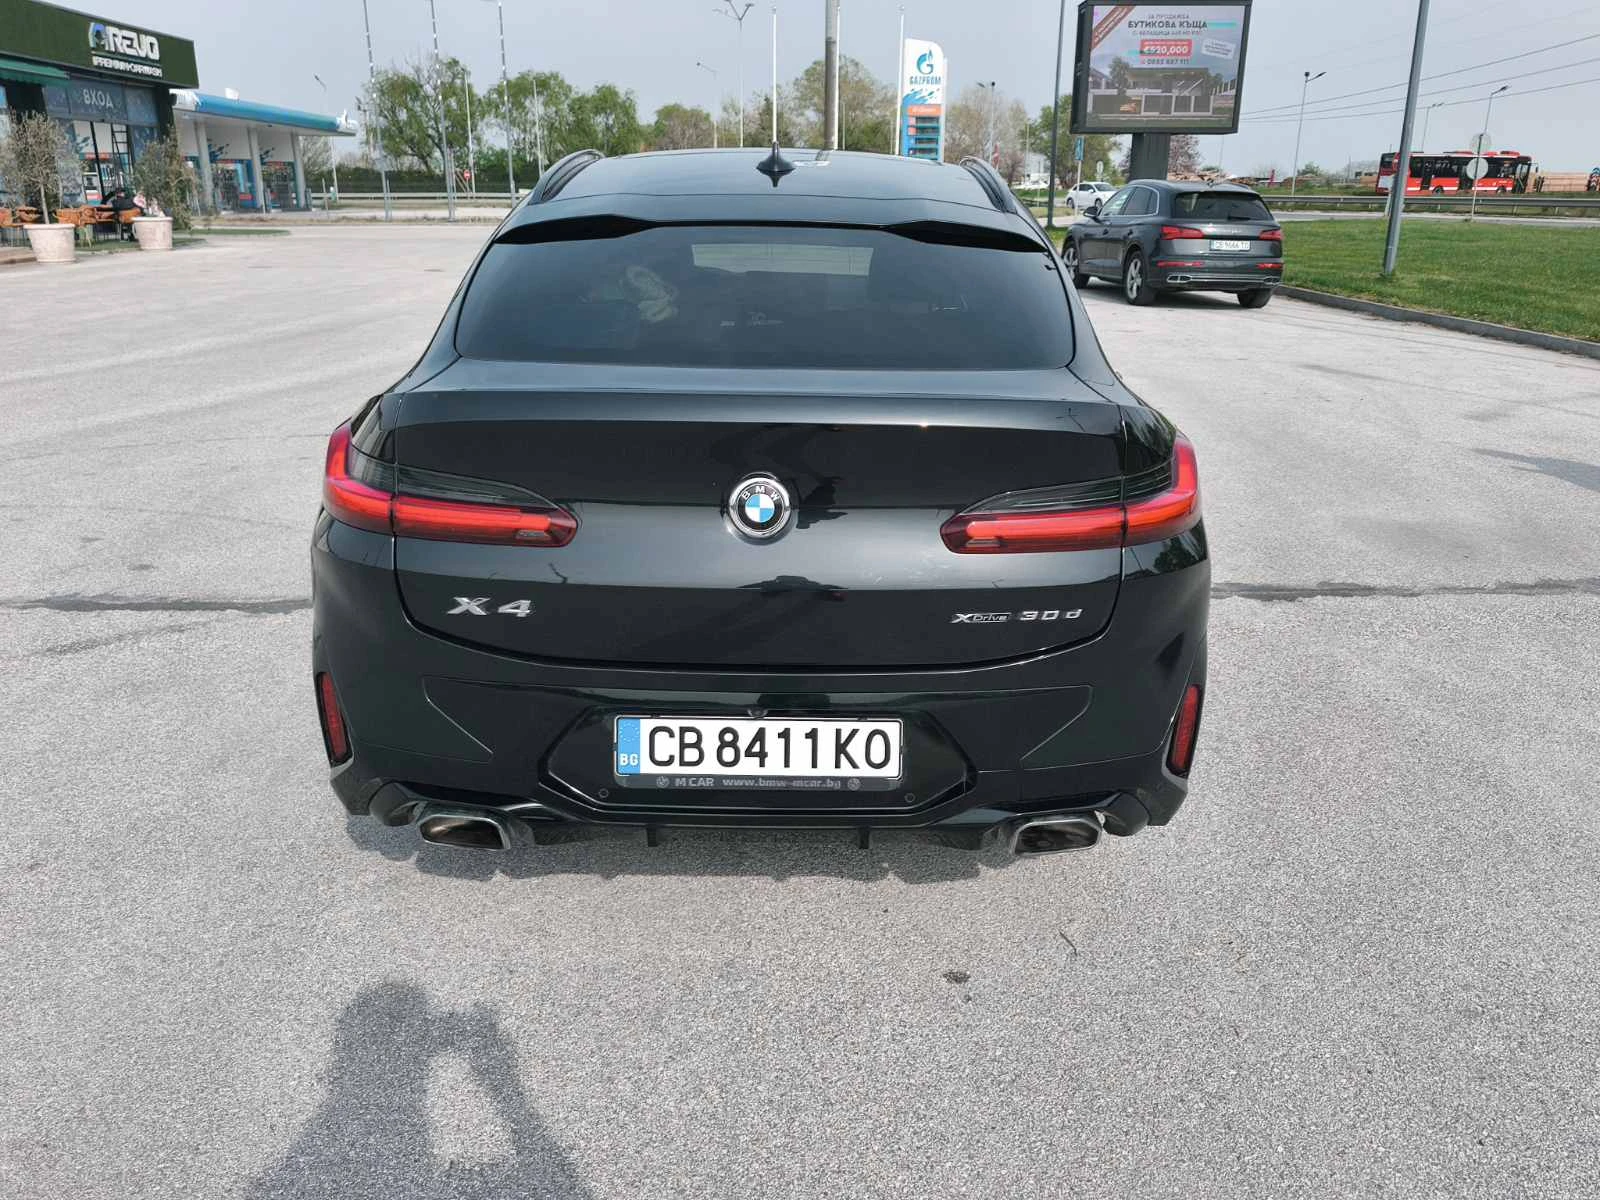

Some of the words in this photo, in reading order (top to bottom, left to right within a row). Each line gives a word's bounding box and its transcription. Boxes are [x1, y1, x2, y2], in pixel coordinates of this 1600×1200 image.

[1128, 20, 1176, 29] БУТИКОВА
[1179, 20, 1208, 30] КЪЩА
[1143, 45, 1189, 56] €520,000
[909, 76, 941, 86] GAZPROM
[83, 89, 114, 109] ВХОД
[741, 485, 781, 501] BMW
[1019, 608, 1083, 621] 30d
[716, 726, 819, 769] 8411
[619, 753, 640, 766] BG
[723, 777, 841, 790] www.bmw-mcar.bg
